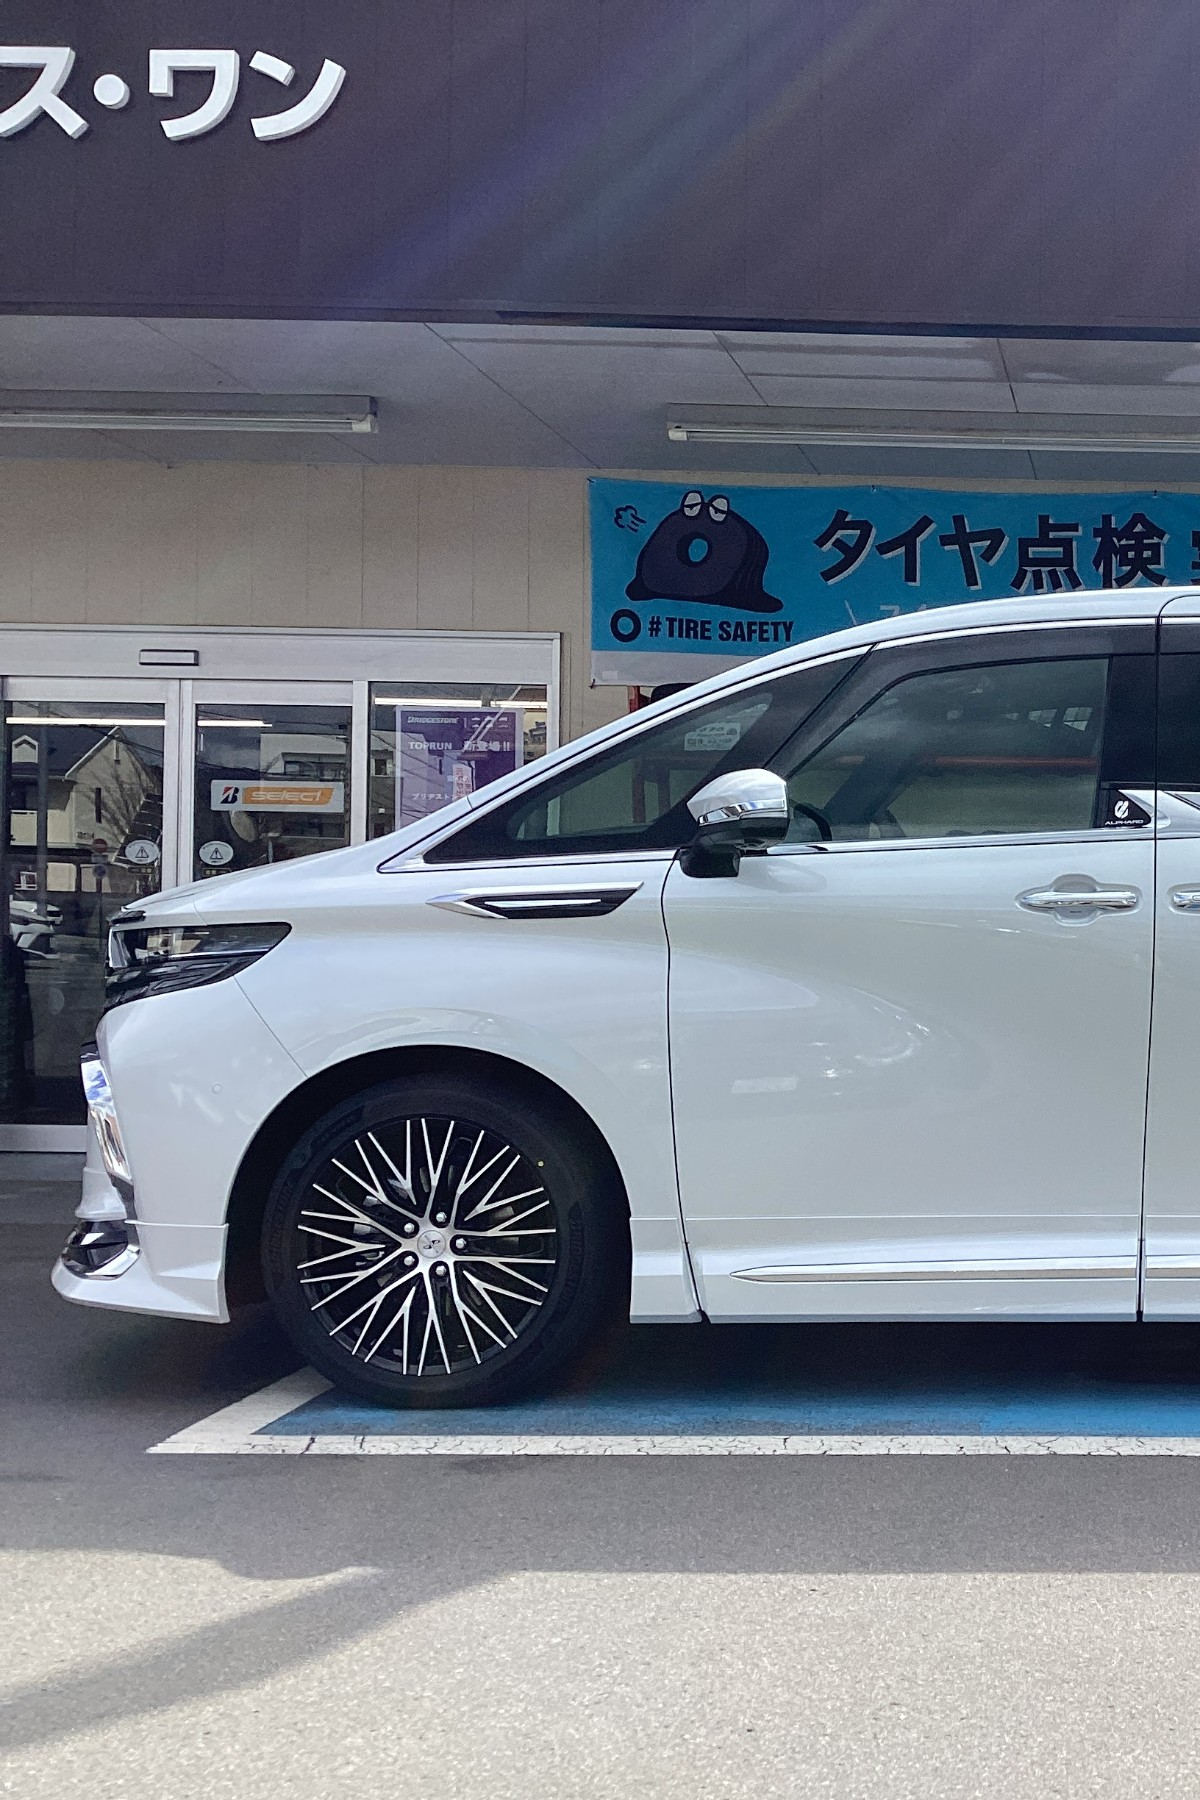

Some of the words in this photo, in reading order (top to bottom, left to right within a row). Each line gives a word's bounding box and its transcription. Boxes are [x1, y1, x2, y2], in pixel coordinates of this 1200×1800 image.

[813, 508, 1171, 595] タイヤ点検
[718, 621, 794, 642] SAFETY
[408, 742, 452, 750] TOPRUN
[251, 791, 320, 802] select
